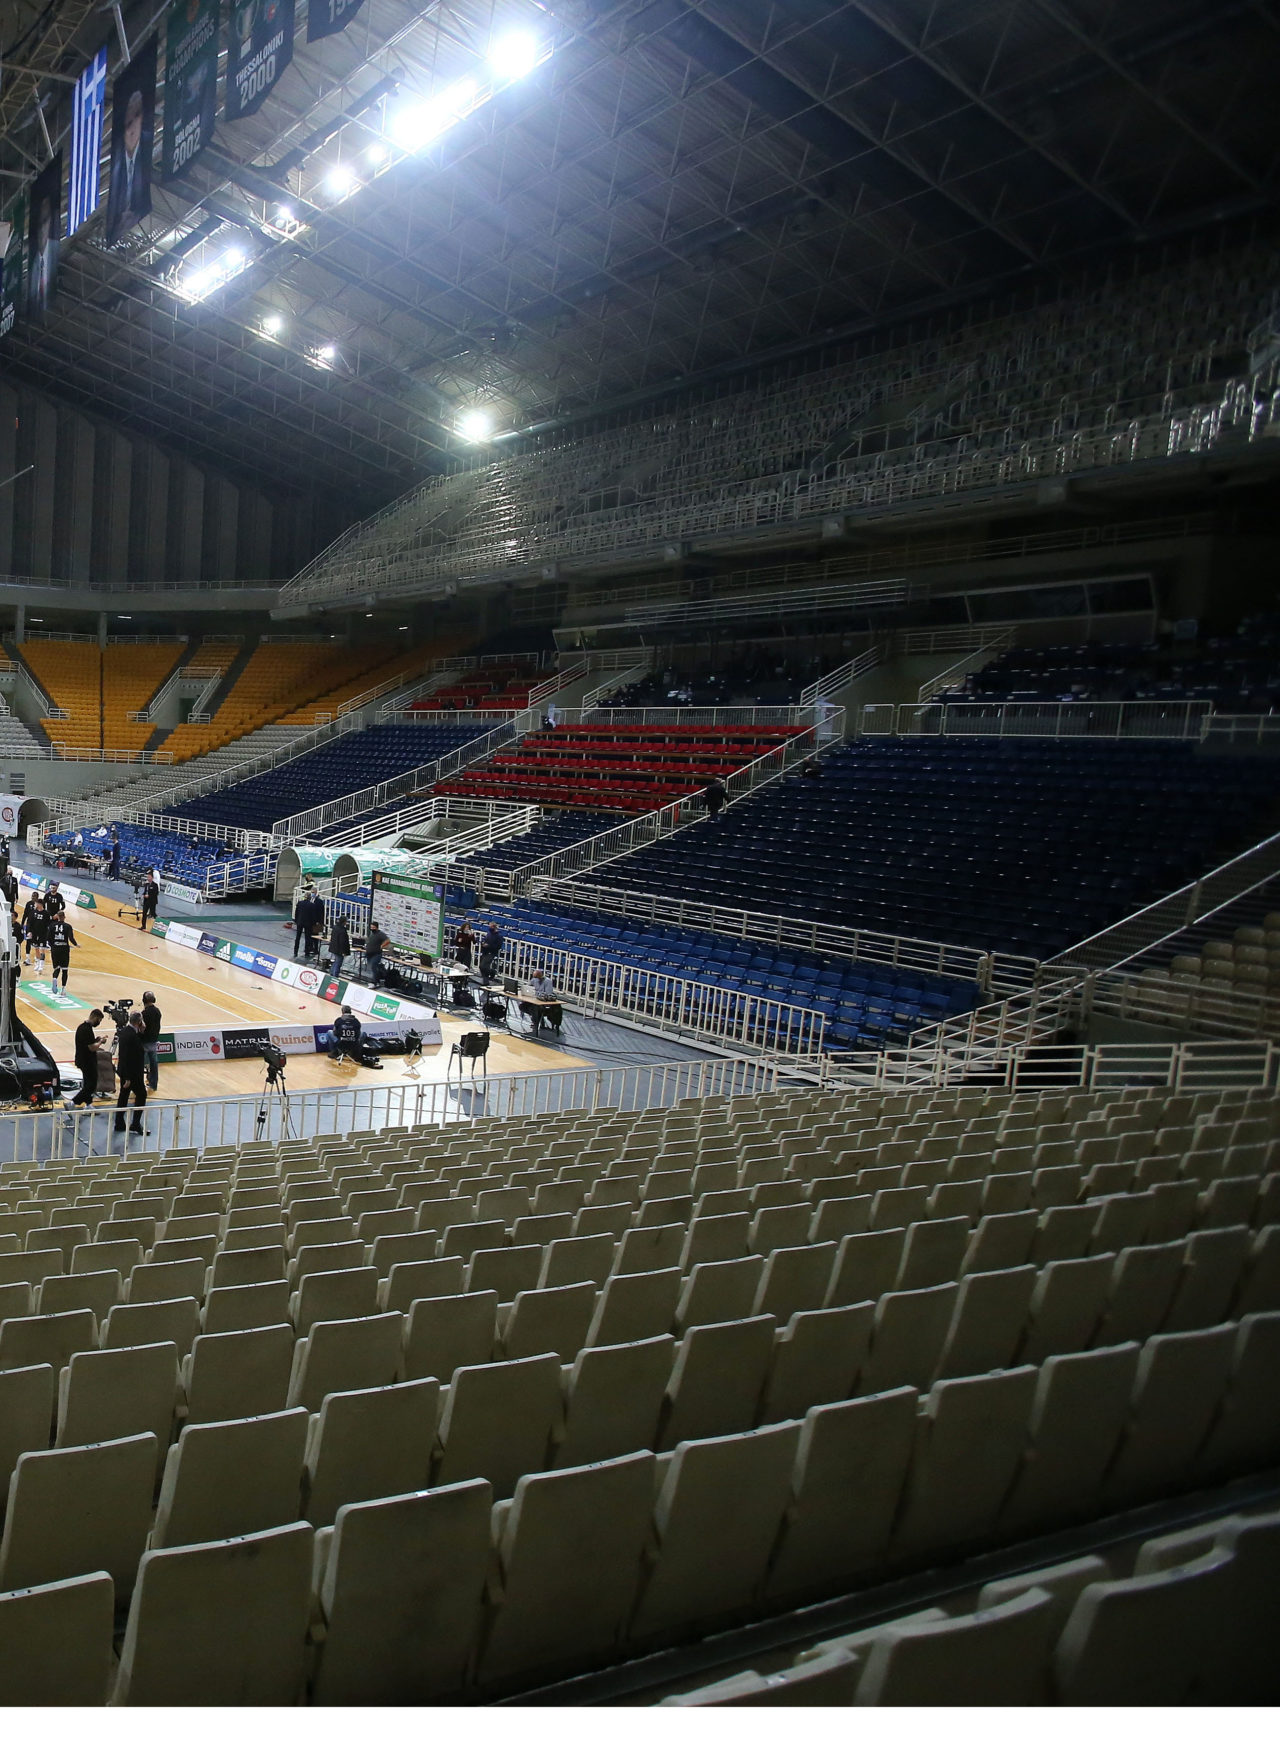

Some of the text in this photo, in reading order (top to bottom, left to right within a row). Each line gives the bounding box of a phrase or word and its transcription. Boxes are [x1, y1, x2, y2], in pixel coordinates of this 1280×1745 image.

[169, 18, 215, 80] CHAMPIONS
[235, 30, 284, 87] THESSALONIKI
[240, 55, 276, 110] 2000
[175, 113, 200, 147] BOLOGNA
[172, 127, 201, 174] 2002
[172, 886, 198, 901] COSMOTE
[177, 1041, 209, 1050] INDIBA
[225, 1036, 270, 1045] MATRIX
[271, 1034, 313, 1047] Quince
